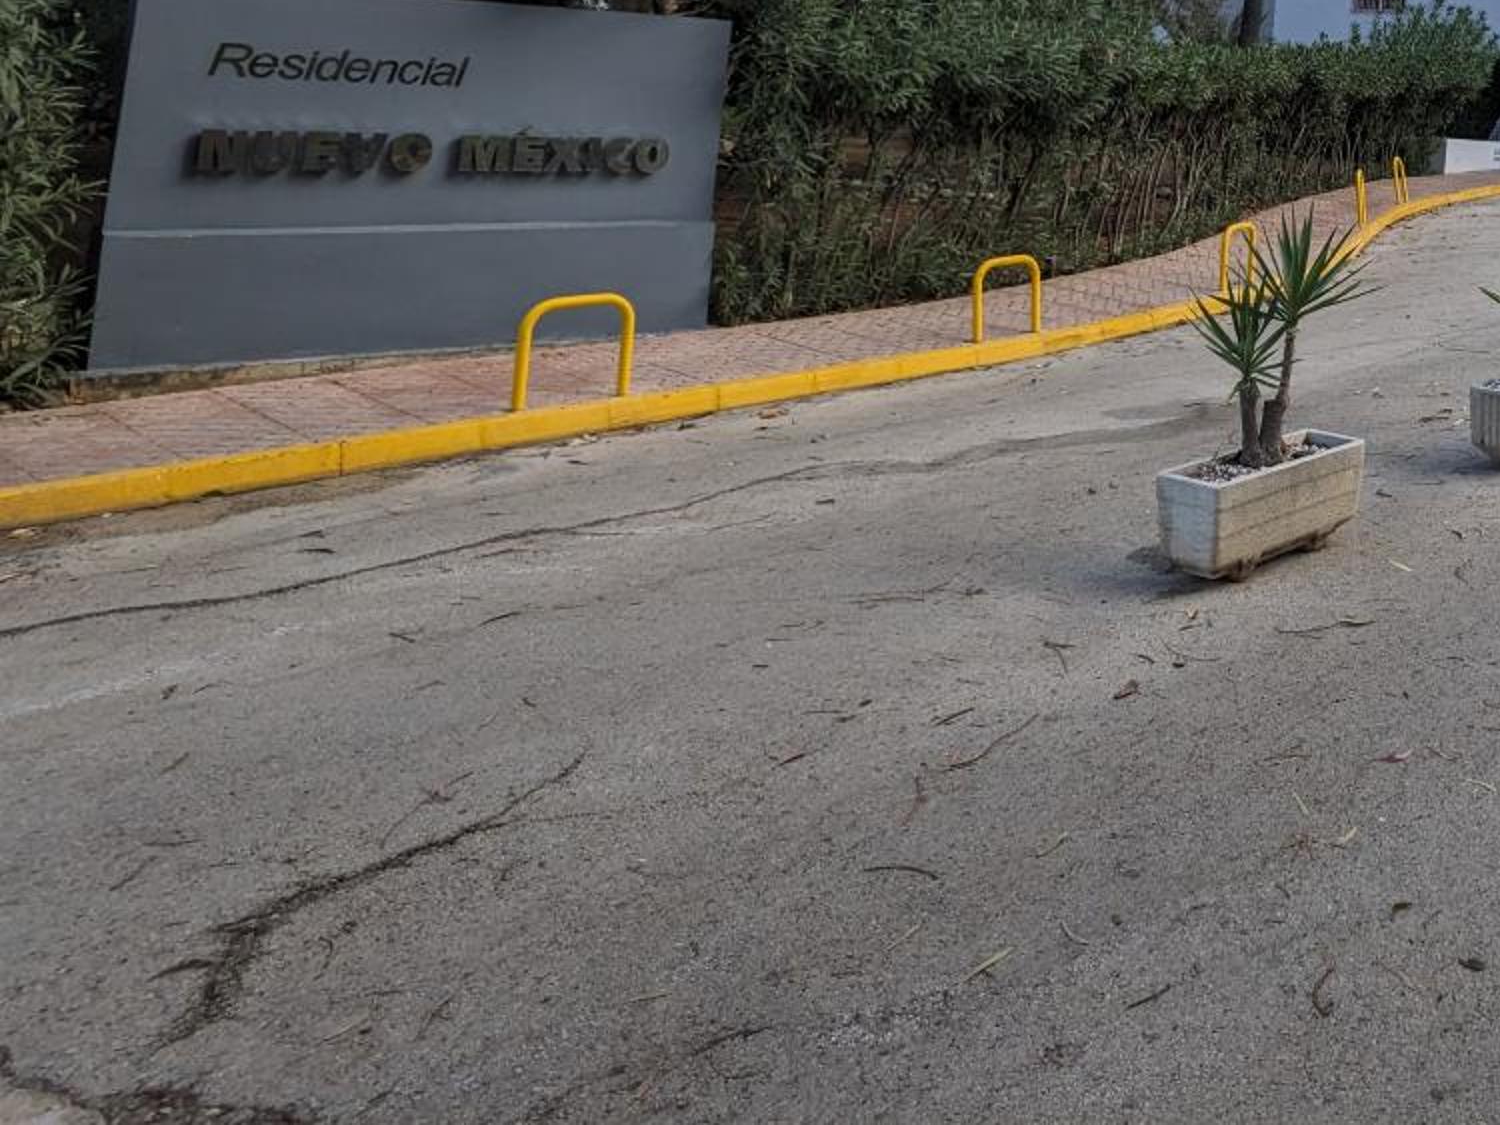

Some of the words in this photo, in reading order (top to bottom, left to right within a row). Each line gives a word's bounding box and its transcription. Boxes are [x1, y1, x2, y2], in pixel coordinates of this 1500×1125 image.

[207, 42, 470, 88] Residencial
[190, 129, 433, 177] NUEVO
[455, 125, 670, 176] MÉXICO
